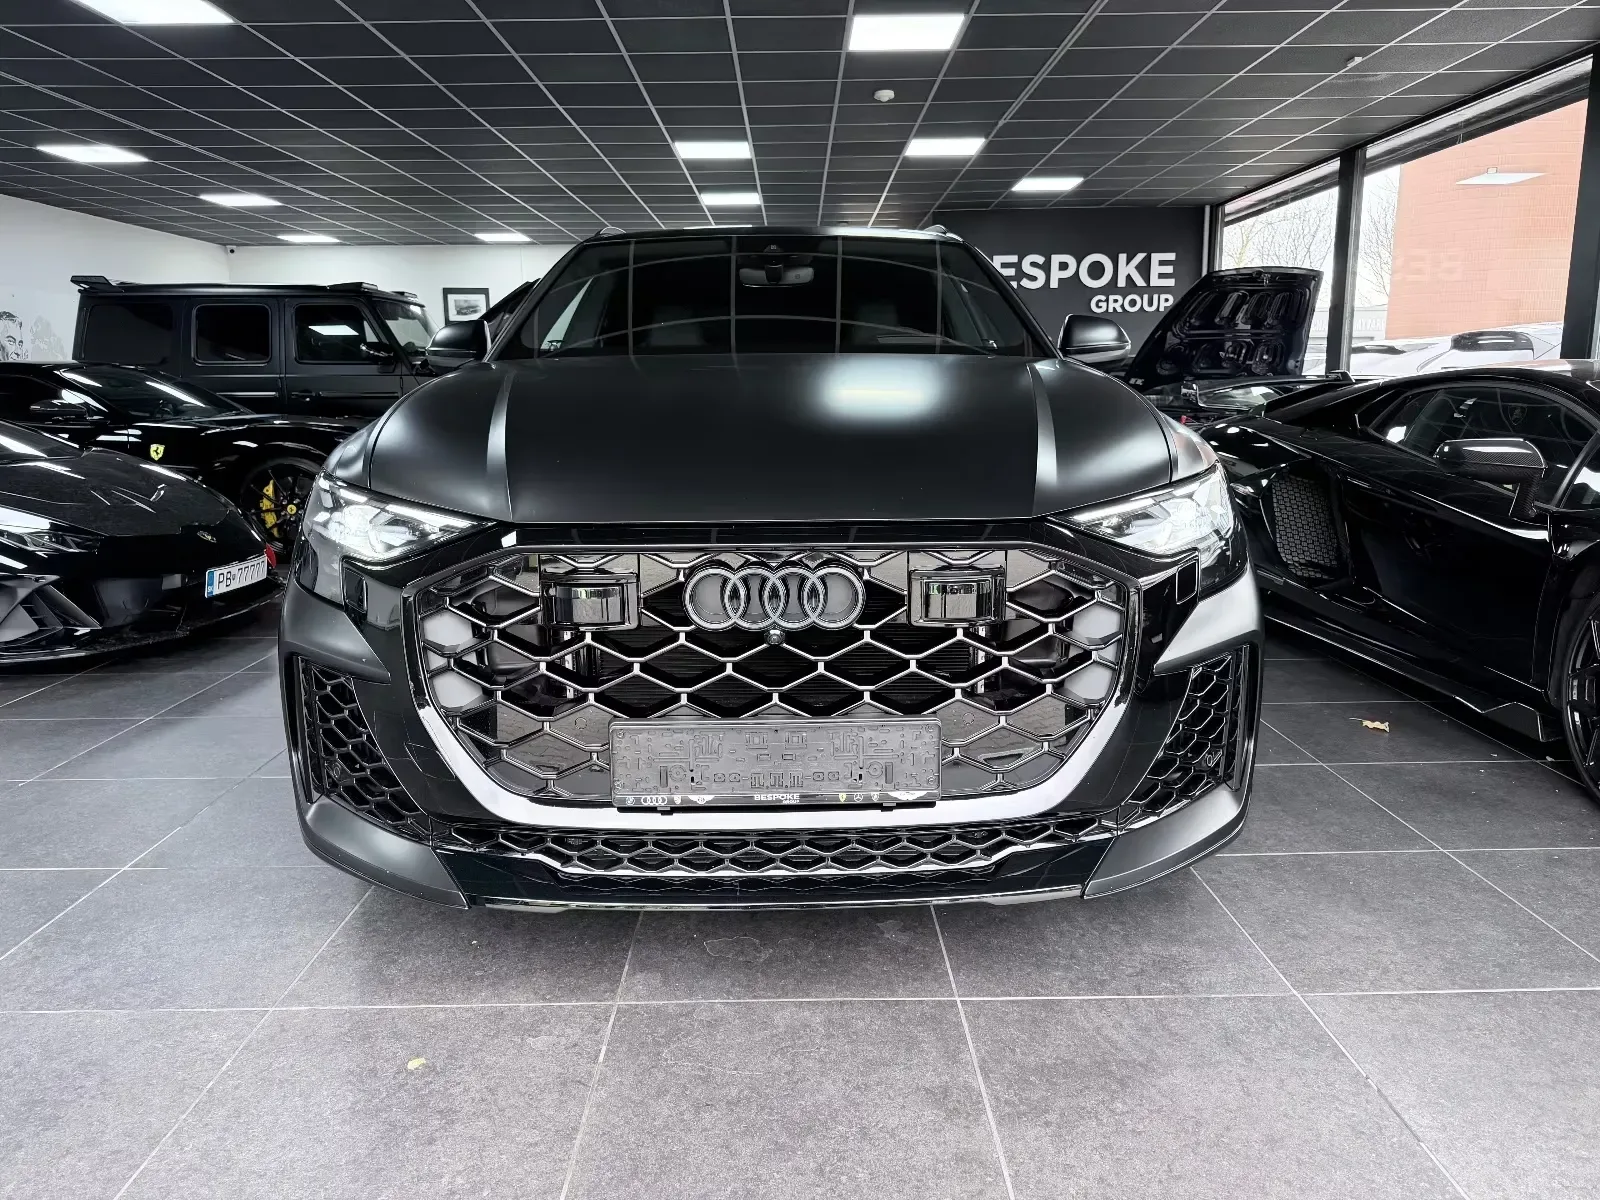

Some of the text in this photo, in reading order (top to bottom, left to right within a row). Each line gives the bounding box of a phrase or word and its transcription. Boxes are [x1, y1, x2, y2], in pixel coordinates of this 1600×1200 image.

[993, 253, 1176, 289] ESPOKE
[1090, 293, 1174, 313] GROUP
[218, 571, 232, 590] PB
[754, 793, 800, 801] BESPOKE
